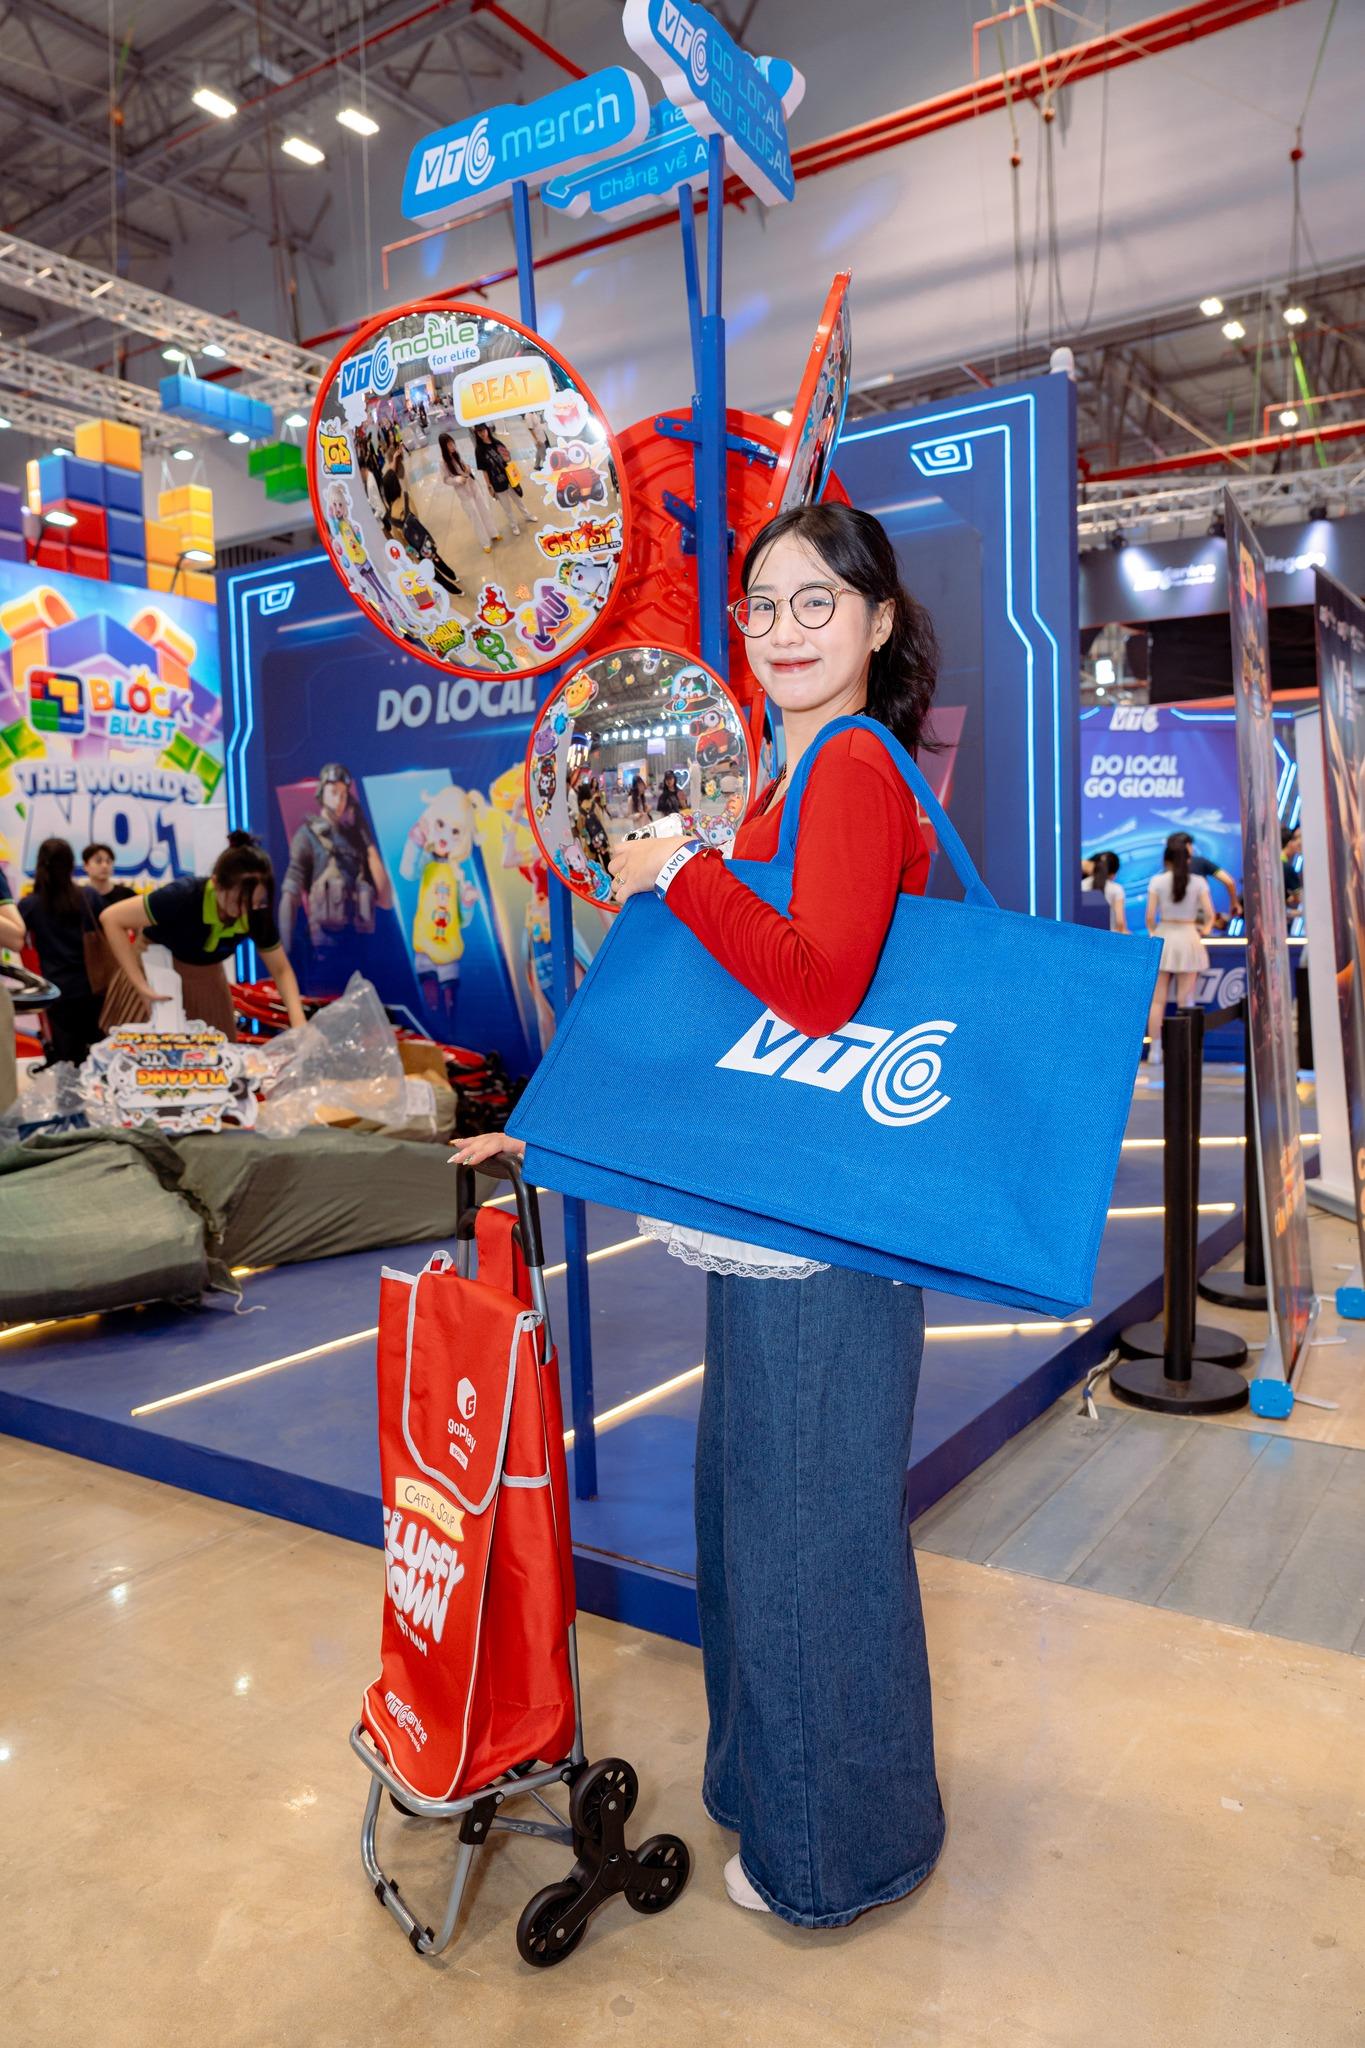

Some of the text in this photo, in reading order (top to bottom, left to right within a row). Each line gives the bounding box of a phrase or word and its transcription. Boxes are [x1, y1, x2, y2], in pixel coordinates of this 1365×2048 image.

[657, 0, 709, 86] VTC
[712, 39, 783, 140] DO LOCAL
[415, 88, 620, 196] VTC merch
[711, 78, 791, 185] GO GLOBAL
[341, 324, 475, 398] VTC mobile
[432, 347, 477, 366] for eLife
[472, 370, 533, 406] BEAT
[534, 585, 571, 644] AU
[88, 676, 190, 722] BLOCK
[376, 677, 537, 732] DO LOCAL
[109, 715, 176, 742] BLAST
[17, 765, 203, 804] THE WORLD'S
[1090, 754, 1178, 776] DO LOCAL
[1083, 777, 1185, 798] GO GLOBAL
[660, 853, 686, 882] DAY 1
[715, 1007, 958, 1127] VTC
[447, 1418, 477, 1453] goPlay
[385, 1690, 411, 1728] VTC
